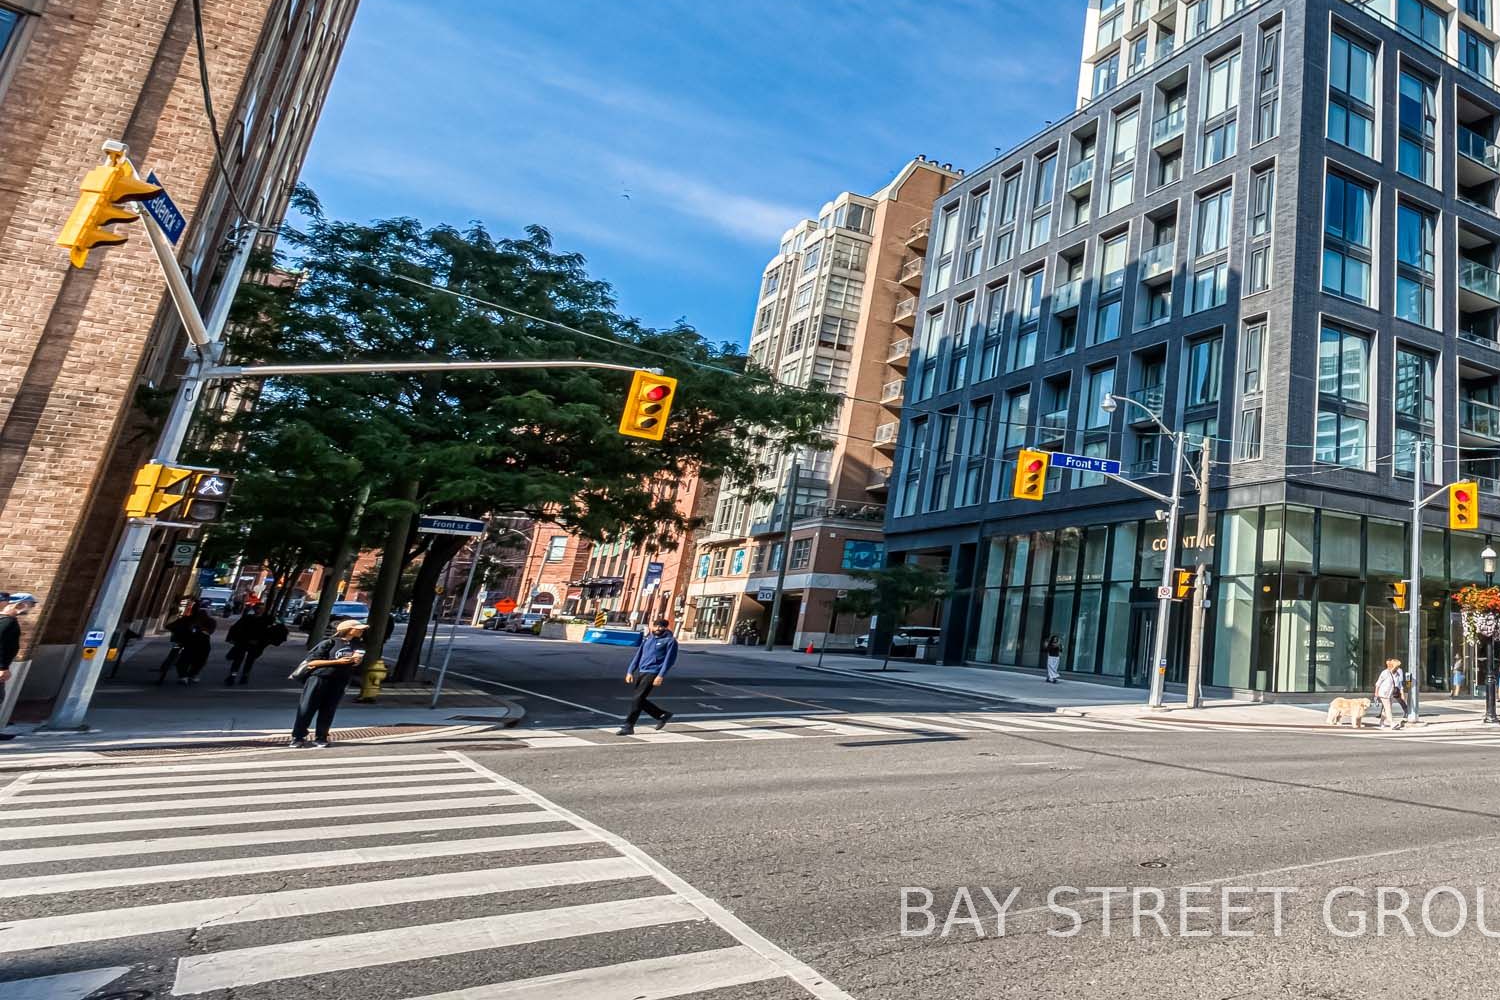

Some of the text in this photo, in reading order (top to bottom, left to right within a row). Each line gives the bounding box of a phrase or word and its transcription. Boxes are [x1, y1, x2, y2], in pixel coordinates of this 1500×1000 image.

[1066, 456, 1092, 469] Front
[1101, 461, 1107, 471] E
[432, 519, 455, 529] Front
[759, 591, 772, 600] 30
